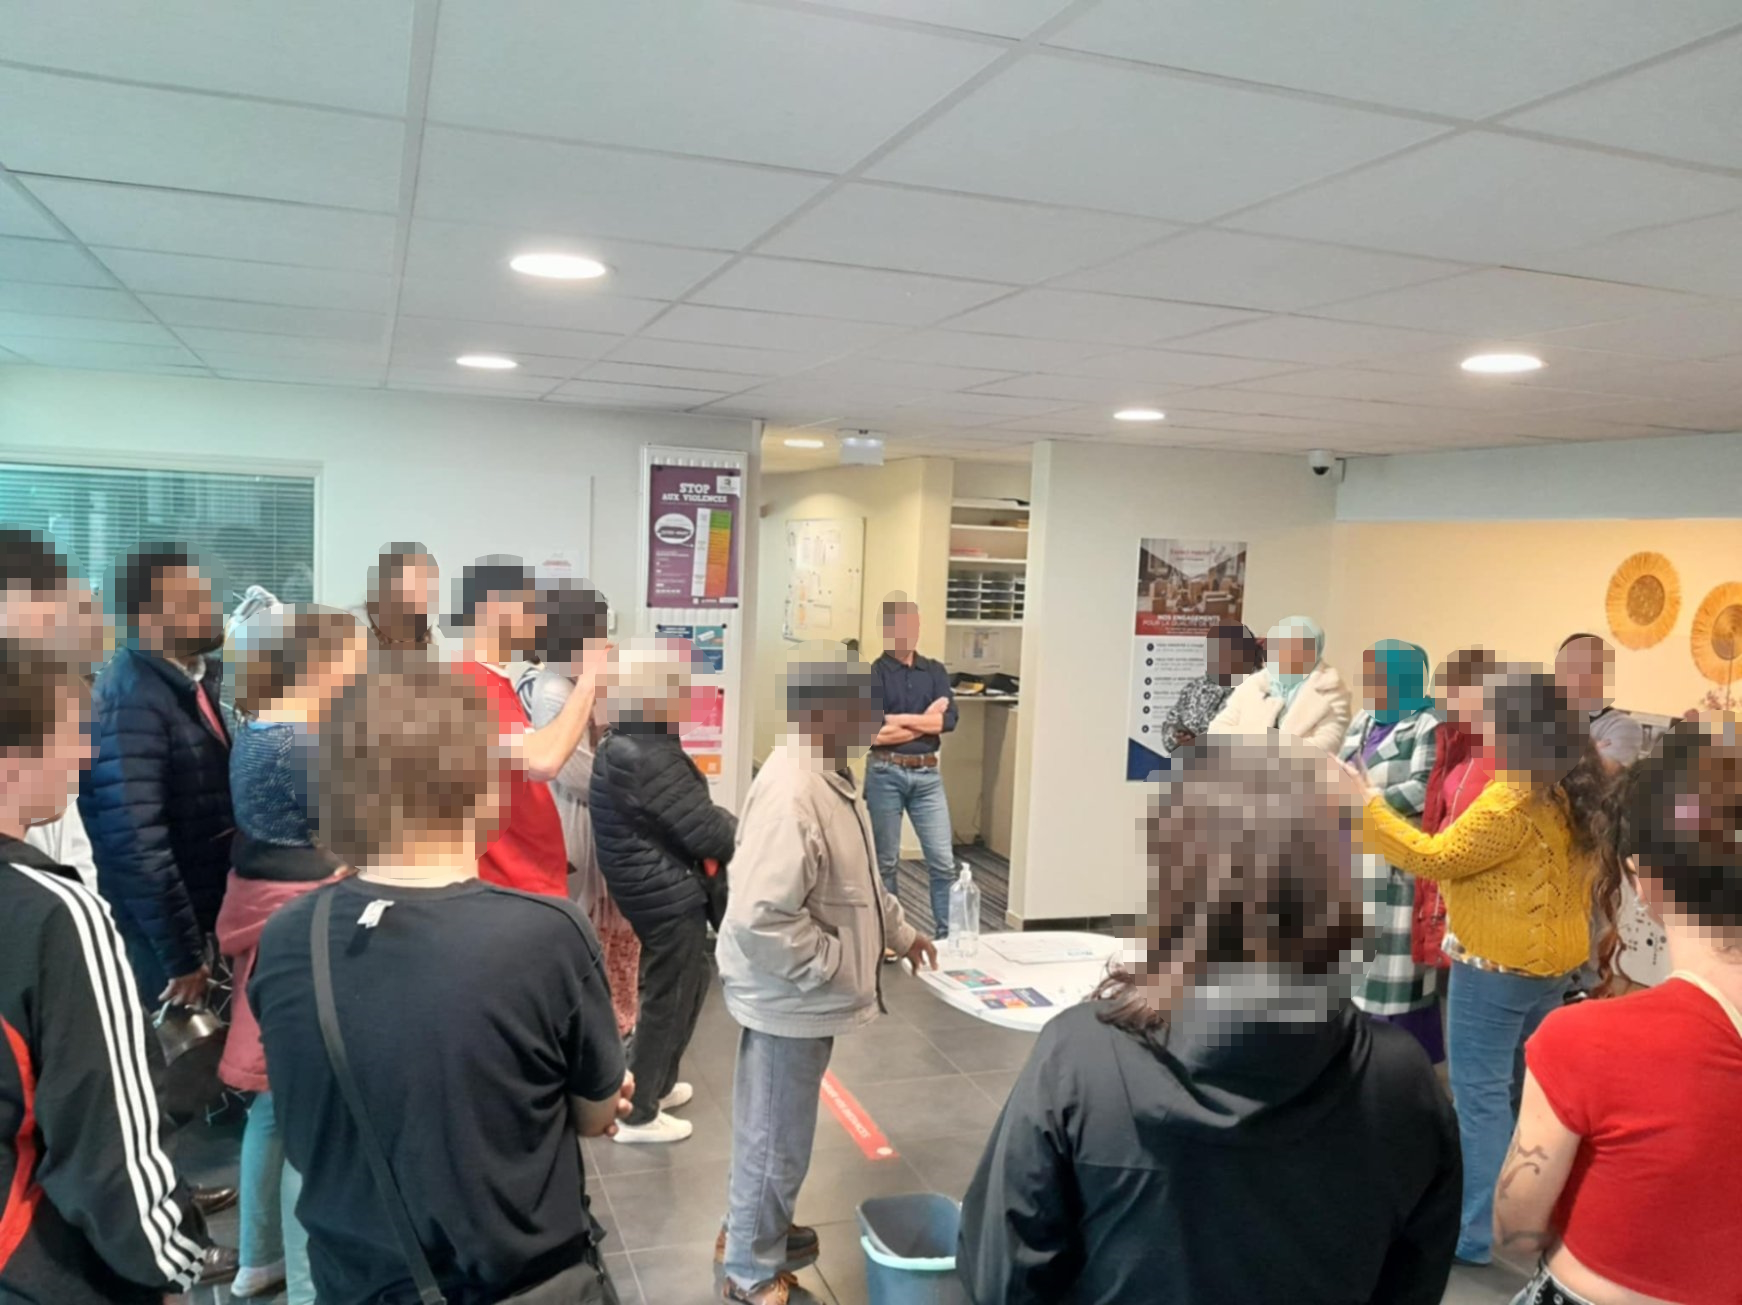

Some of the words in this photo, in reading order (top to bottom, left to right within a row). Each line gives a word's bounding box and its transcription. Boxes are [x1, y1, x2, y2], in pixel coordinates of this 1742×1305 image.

[679, 483, 710, 494] STOP
[662, 493, 680, 501] AUX
[683, 495, 728, 503] VIOLENCES
